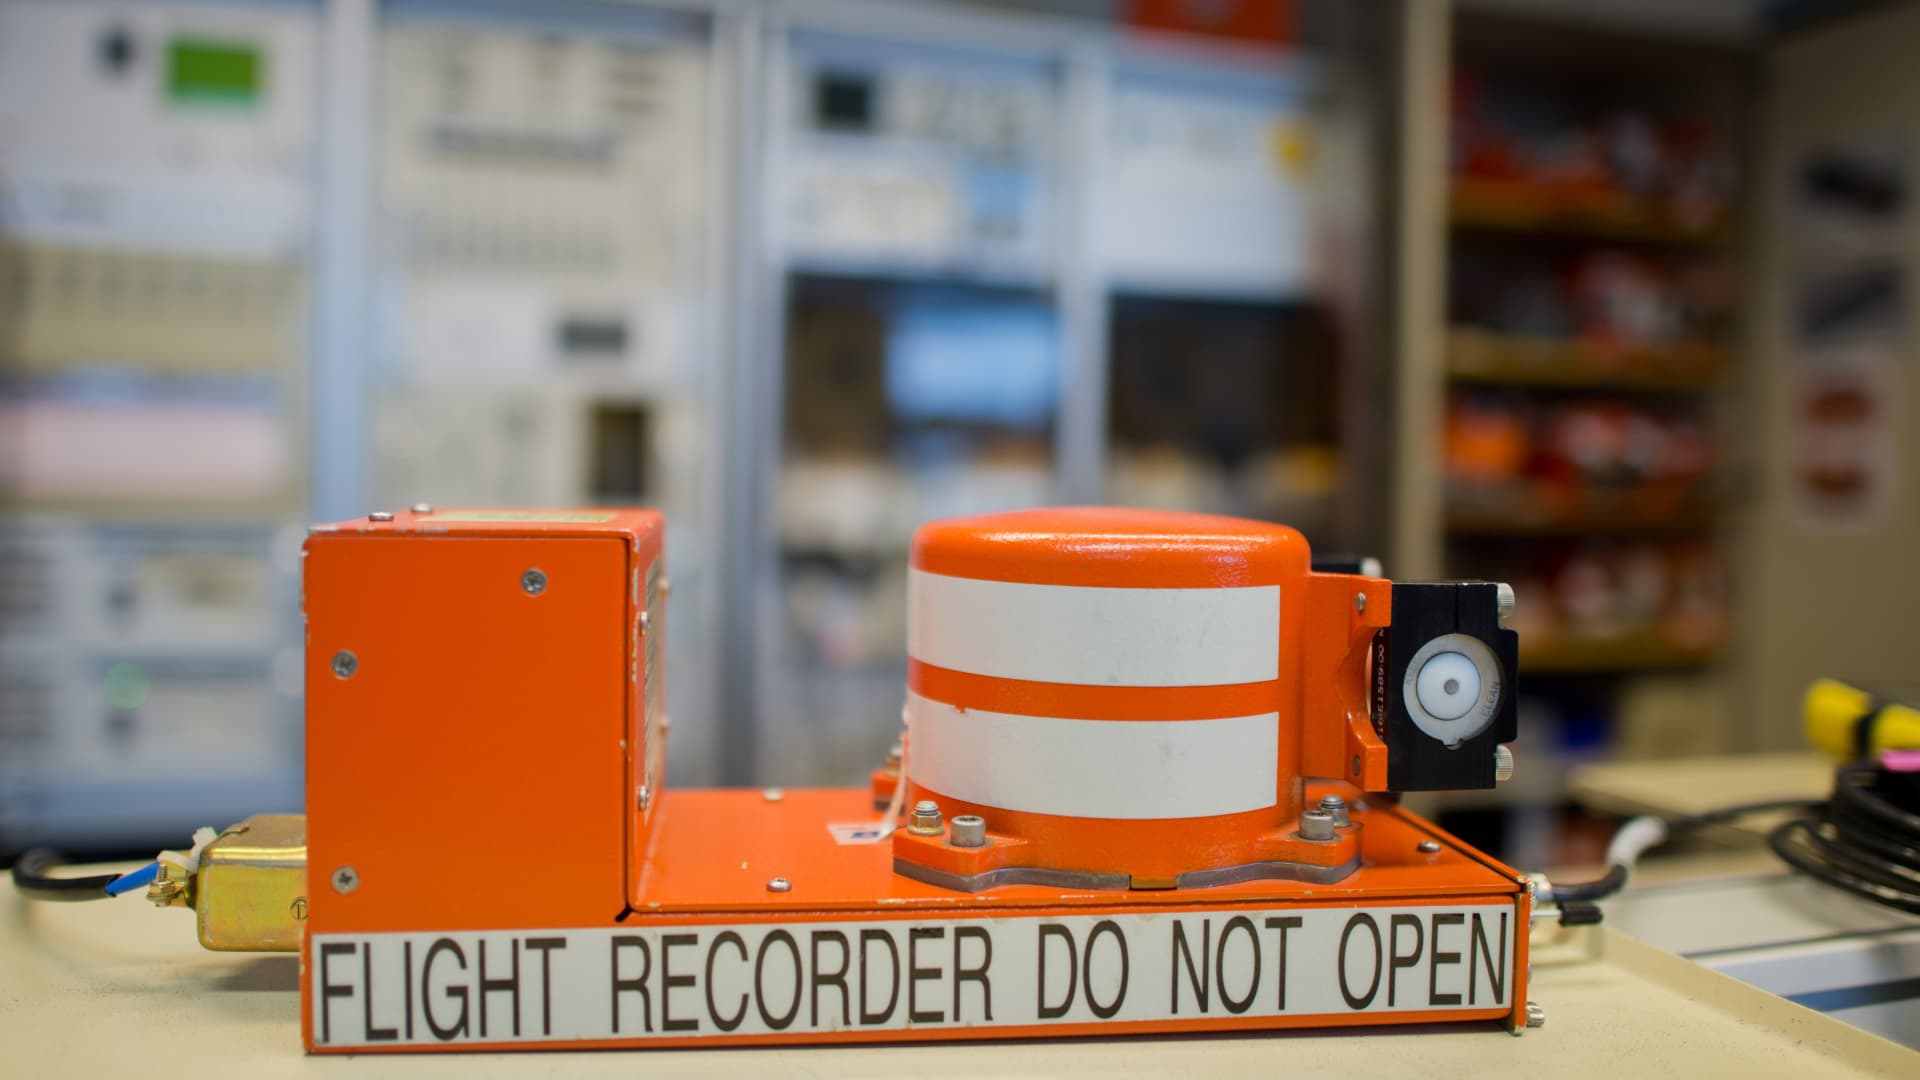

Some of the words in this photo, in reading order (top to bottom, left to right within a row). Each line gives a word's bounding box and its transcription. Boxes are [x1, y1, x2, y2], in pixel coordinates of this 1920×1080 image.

[320, 937, 567, 1043] FLIGHT
[611, 926, 993, 1033] RECORDER
[1037, 919, 1130, 1019] DO
[1171, 915, 1303, 1014] NOT
[1337, 912, 1507, 1010] OPEN
